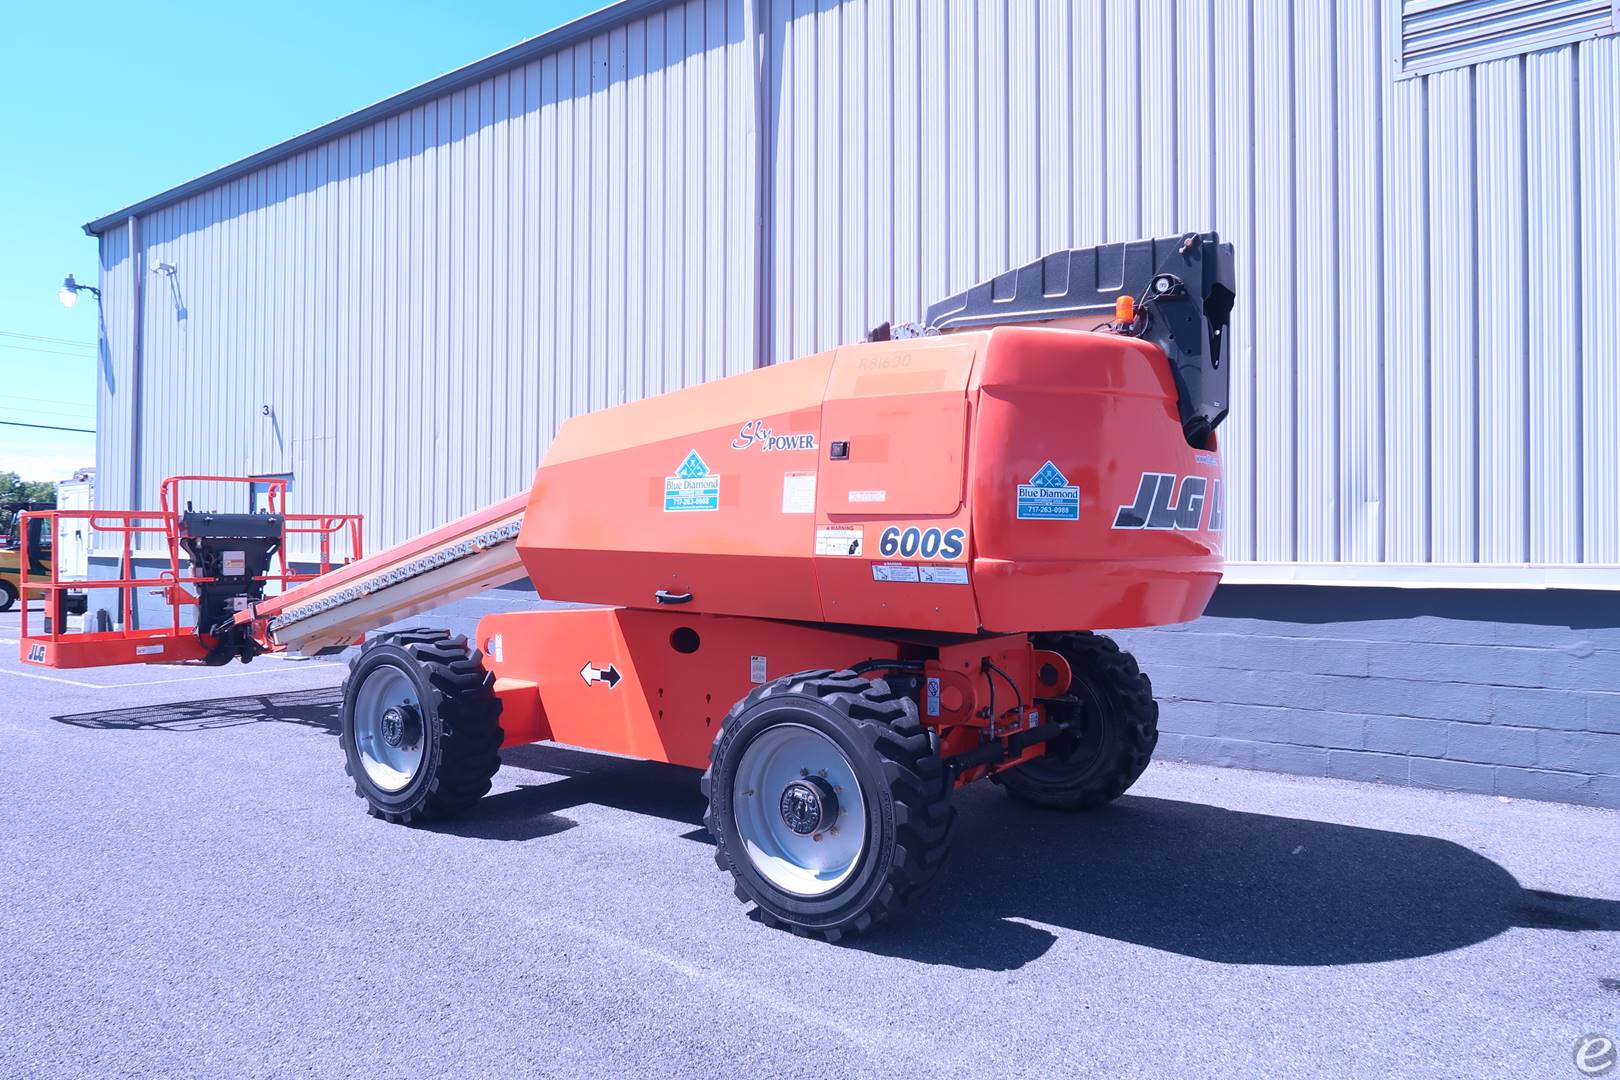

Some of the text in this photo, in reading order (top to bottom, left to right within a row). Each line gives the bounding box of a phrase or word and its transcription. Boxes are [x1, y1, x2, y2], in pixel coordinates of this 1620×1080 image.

[262, 404, 270, 416] 3
[732, 421, 814, 450] Sky POWER
[666, 479, 719, 490] Blue Diamond
[1018, 488, 1078, 499] Blue Diamond
[1112, 472, 1207, 531] JLG
[1028, 505, 1069, 514] 717-263-0988
[879, 526, 966, 559] 600S
[28, 645, 47, 662] JLG
